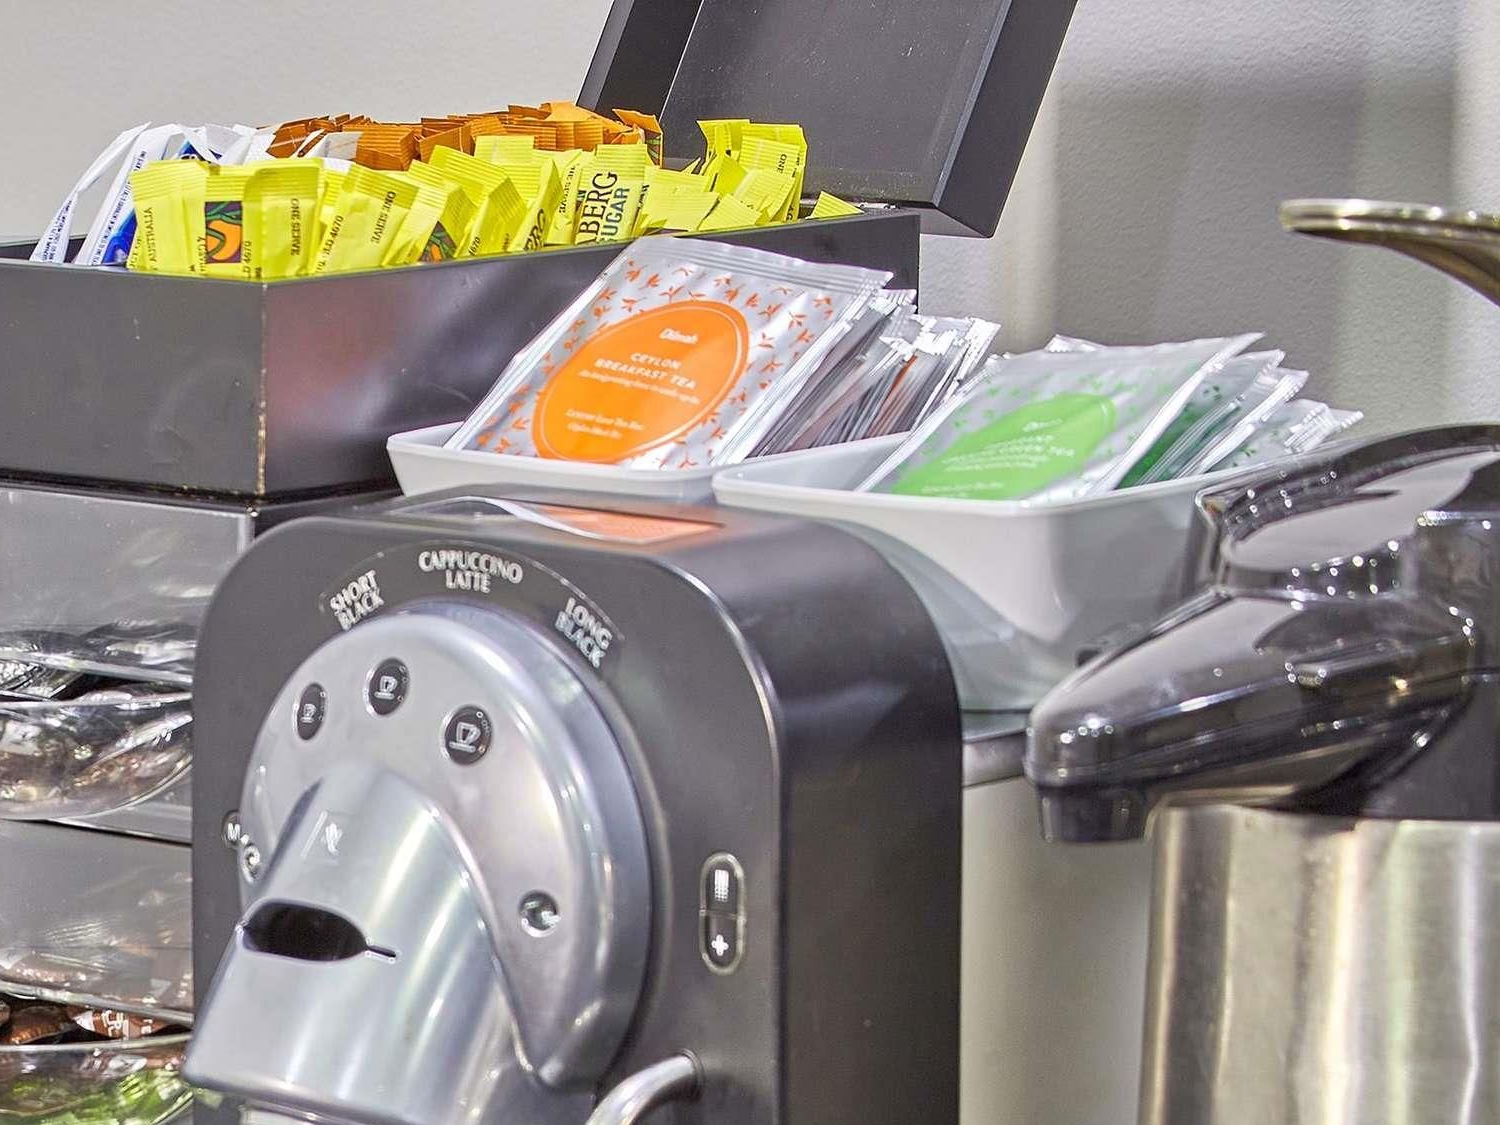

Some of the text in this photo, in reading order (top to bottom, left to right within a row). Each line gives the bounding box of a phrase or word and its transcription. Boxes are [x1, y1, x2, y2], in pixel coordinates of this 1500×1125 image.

[291, 198, 301, 255] ONE SERVE
[329, 214, 345, 240] 4670
[577, 172, 619, 244] BERG
[143, 206, 156, 263] AUSTRALIA
[595, 358, 669, 380] BREAKFAST
[670, 374, 697, 390] TEA
[630, 352, 682, 369] CEYLON
[418, 550, 524, 584] CAPPUCCINO
[445, 570, 491, 594] LATTE
[330, 569, 377, 612] SHORT
[335, 588, 385, 631] BLACK
[554, 611, 606, 669] BLACK
[564, 597, 614, 651] LONG
